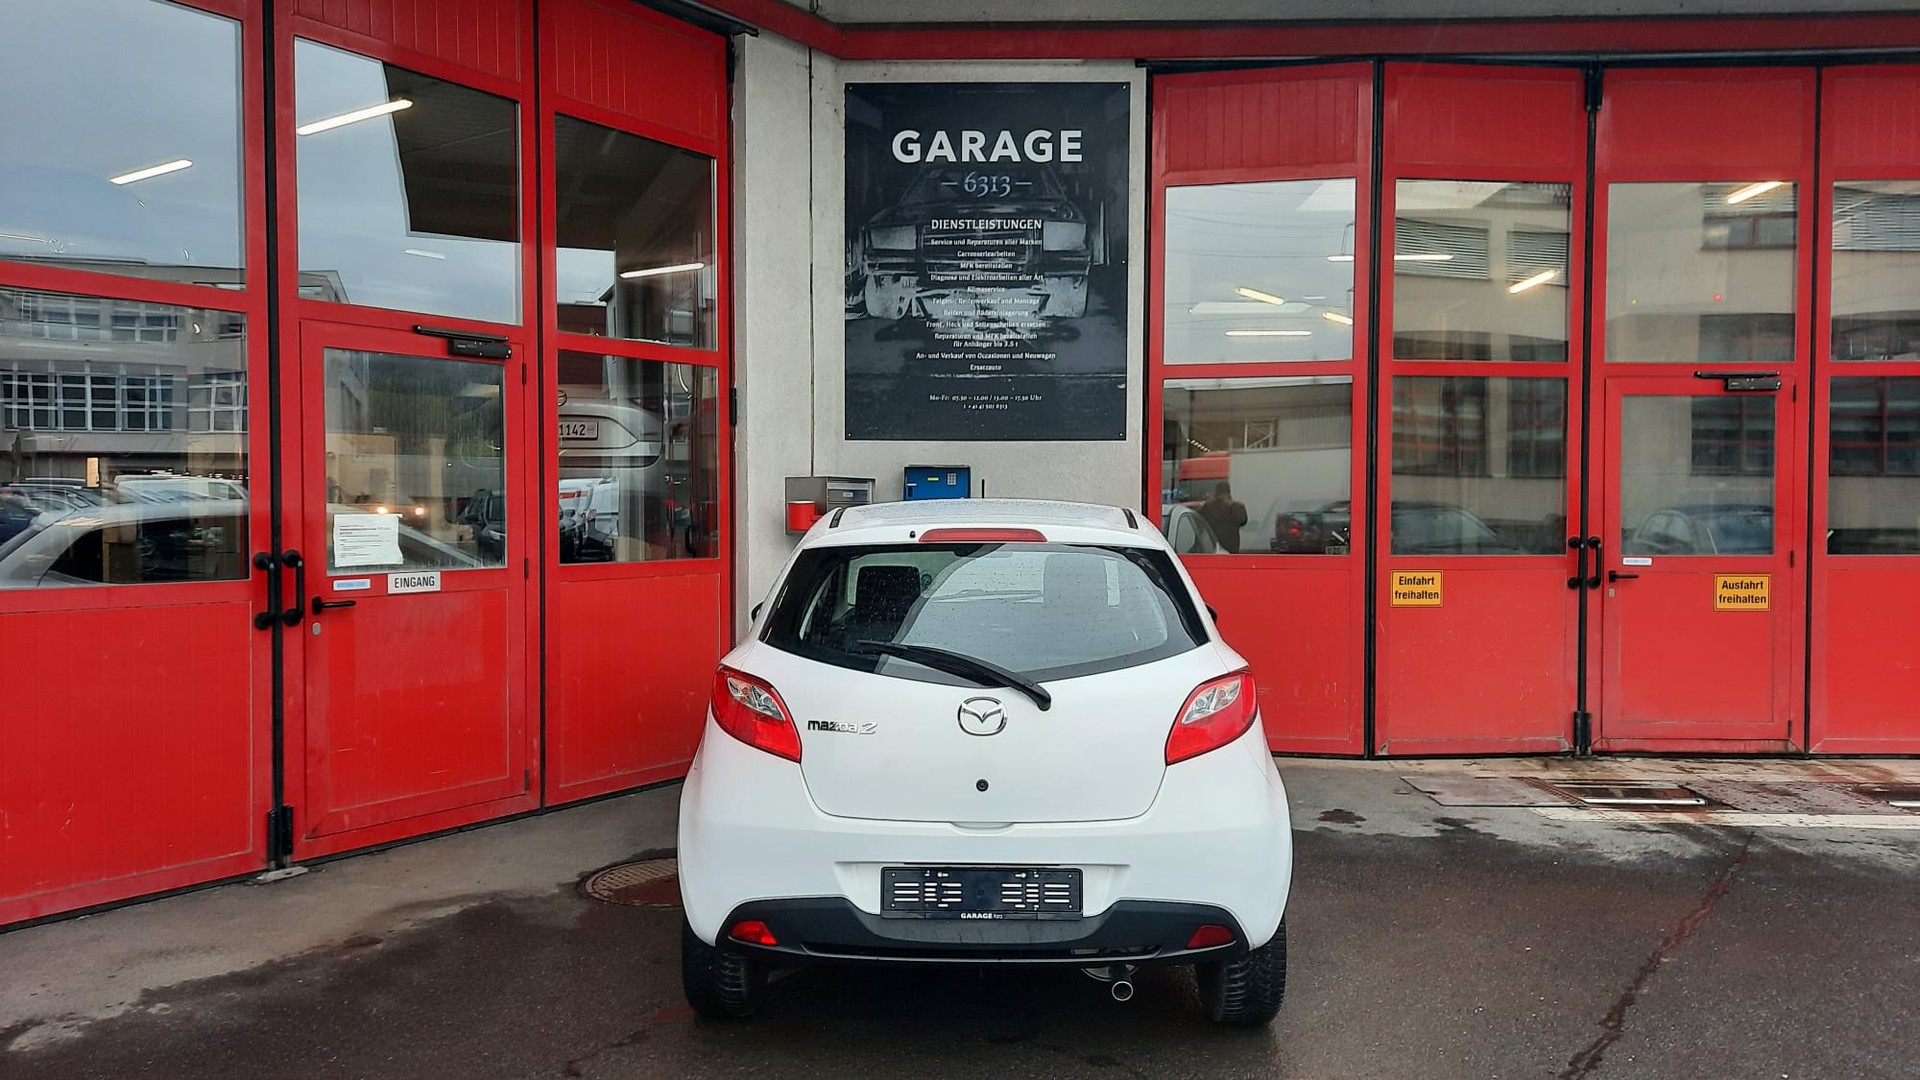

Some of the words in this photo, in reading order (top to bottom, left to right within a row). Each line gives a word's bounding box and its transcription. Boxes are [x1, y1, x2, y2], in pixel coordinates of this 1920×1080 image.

[892, 129, 1083, 163] GARAGE
[964, 171, 1011, 198] 6313
[931, 219, 1042, 230] DIENSTLEISTUNGEN
[966, 239, 1003, 247] Reparaturen
[930, 274, 957, 282] Diagnose
[963, 341, 993, 349] Anhänger
[394, 576, 435, 589] EINGANG
[1398, 576, 1435, 585] Einfahrt
[1721, 580, 1764, 590] Ausfahrt
[1395, 590, 1439, 599] freihalten
[1719, 594, 1767, 604] freihalten
